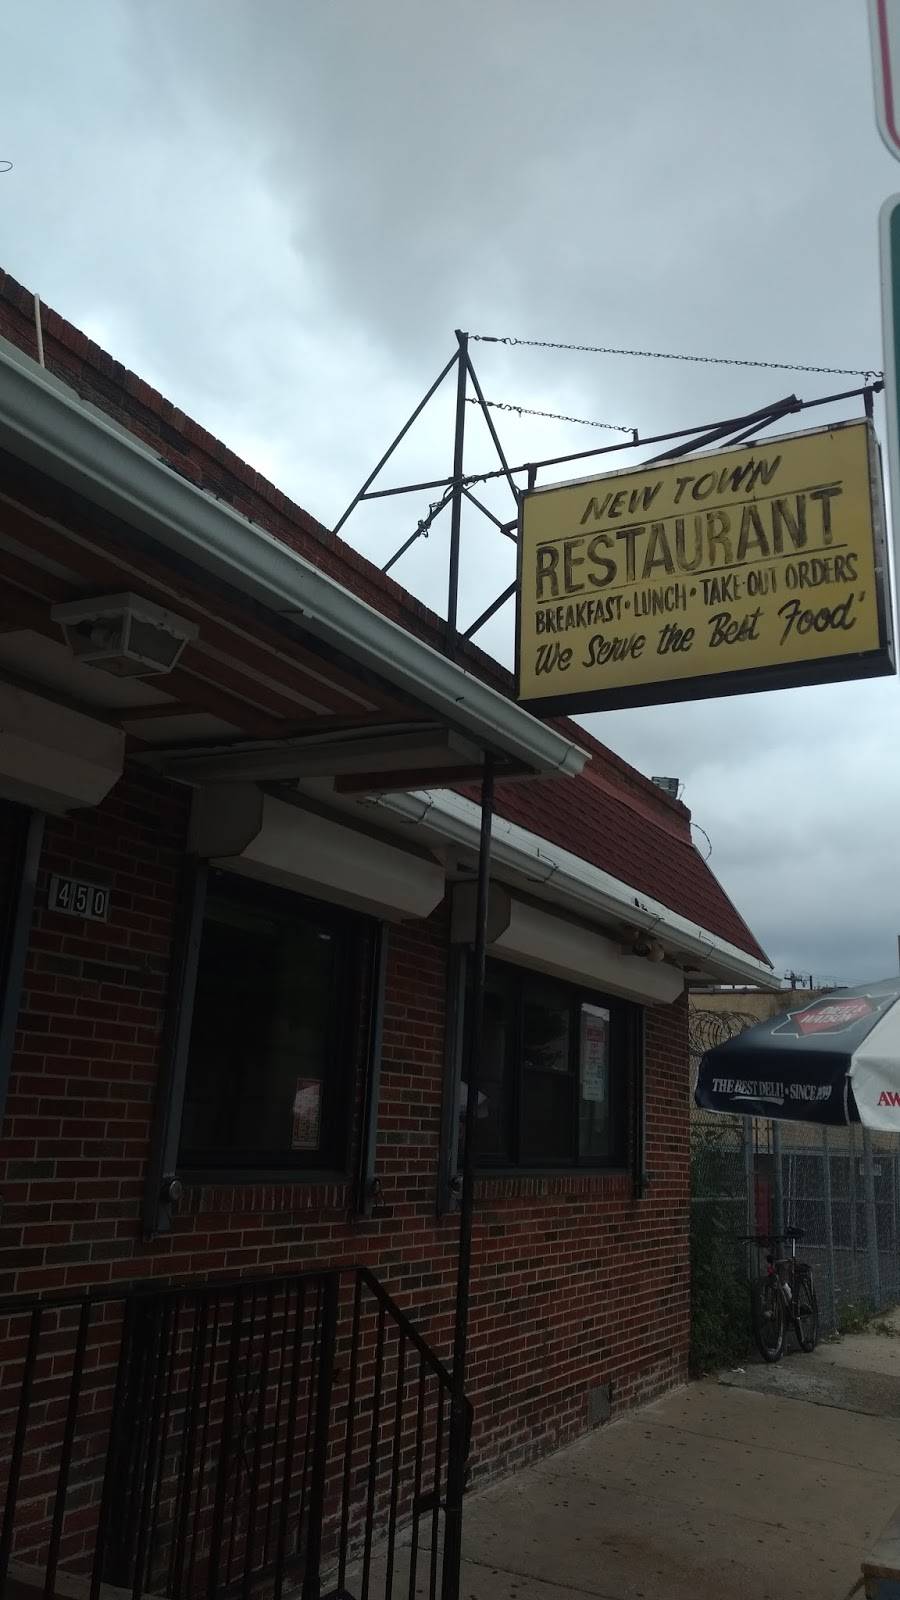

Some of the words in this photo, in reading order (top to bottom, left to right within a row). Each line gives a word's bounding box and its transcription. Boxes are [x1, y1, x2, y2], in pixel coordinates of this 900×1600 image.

[580, 481, 664, 525] NEW
[673, 456, 783, 504] TOWN
[535, 487, 844, 600] RESTAURANT
[536, 595, 623, 635] BREAKFAST
[634, 583, 687, 617] LUNCH
[785, 552, 859, 589] ORDERS
[535, 641, 574, 676] We
[582, 633, 646, 668] Serve
[656, 622, 695, 655] the
[708, 606, 765, 648] Best
[58, 882, 105, 915] 450
[712, 1078, 735, 1093] THE
[734, 1080, 758, 1095] BEST
[790, 1084, 817, 1100] SINCE
